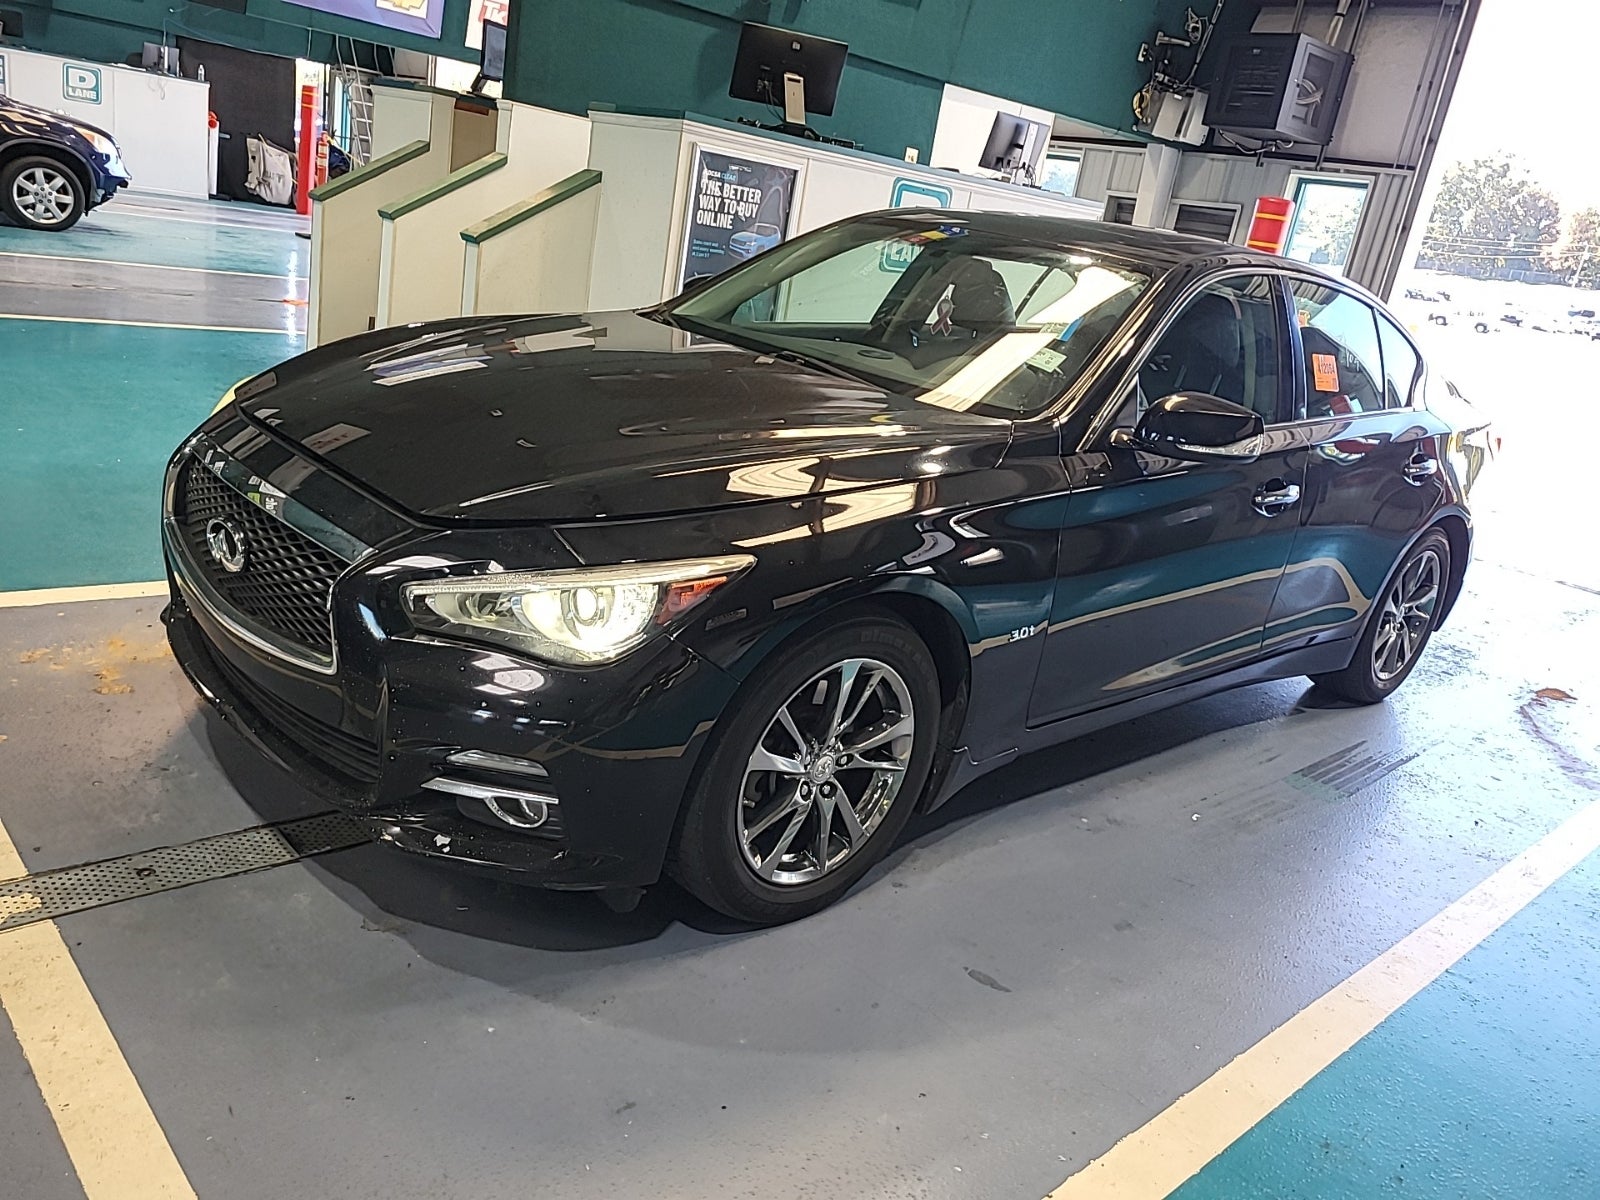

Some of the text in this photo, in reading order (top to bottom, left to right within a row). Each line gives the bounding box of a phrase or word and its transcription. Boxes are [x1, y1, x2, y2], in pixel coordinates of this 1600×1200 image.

[68, 68, 97, 89] D
[68, 87, 97, 100] LANE
[701, 180, 761, 204] THE BETTER
[699, 194, 759, 218] WAY TO BUY
[696, 210, 734, 229] ONLINE
[890, 242, 925, 263] LAN
